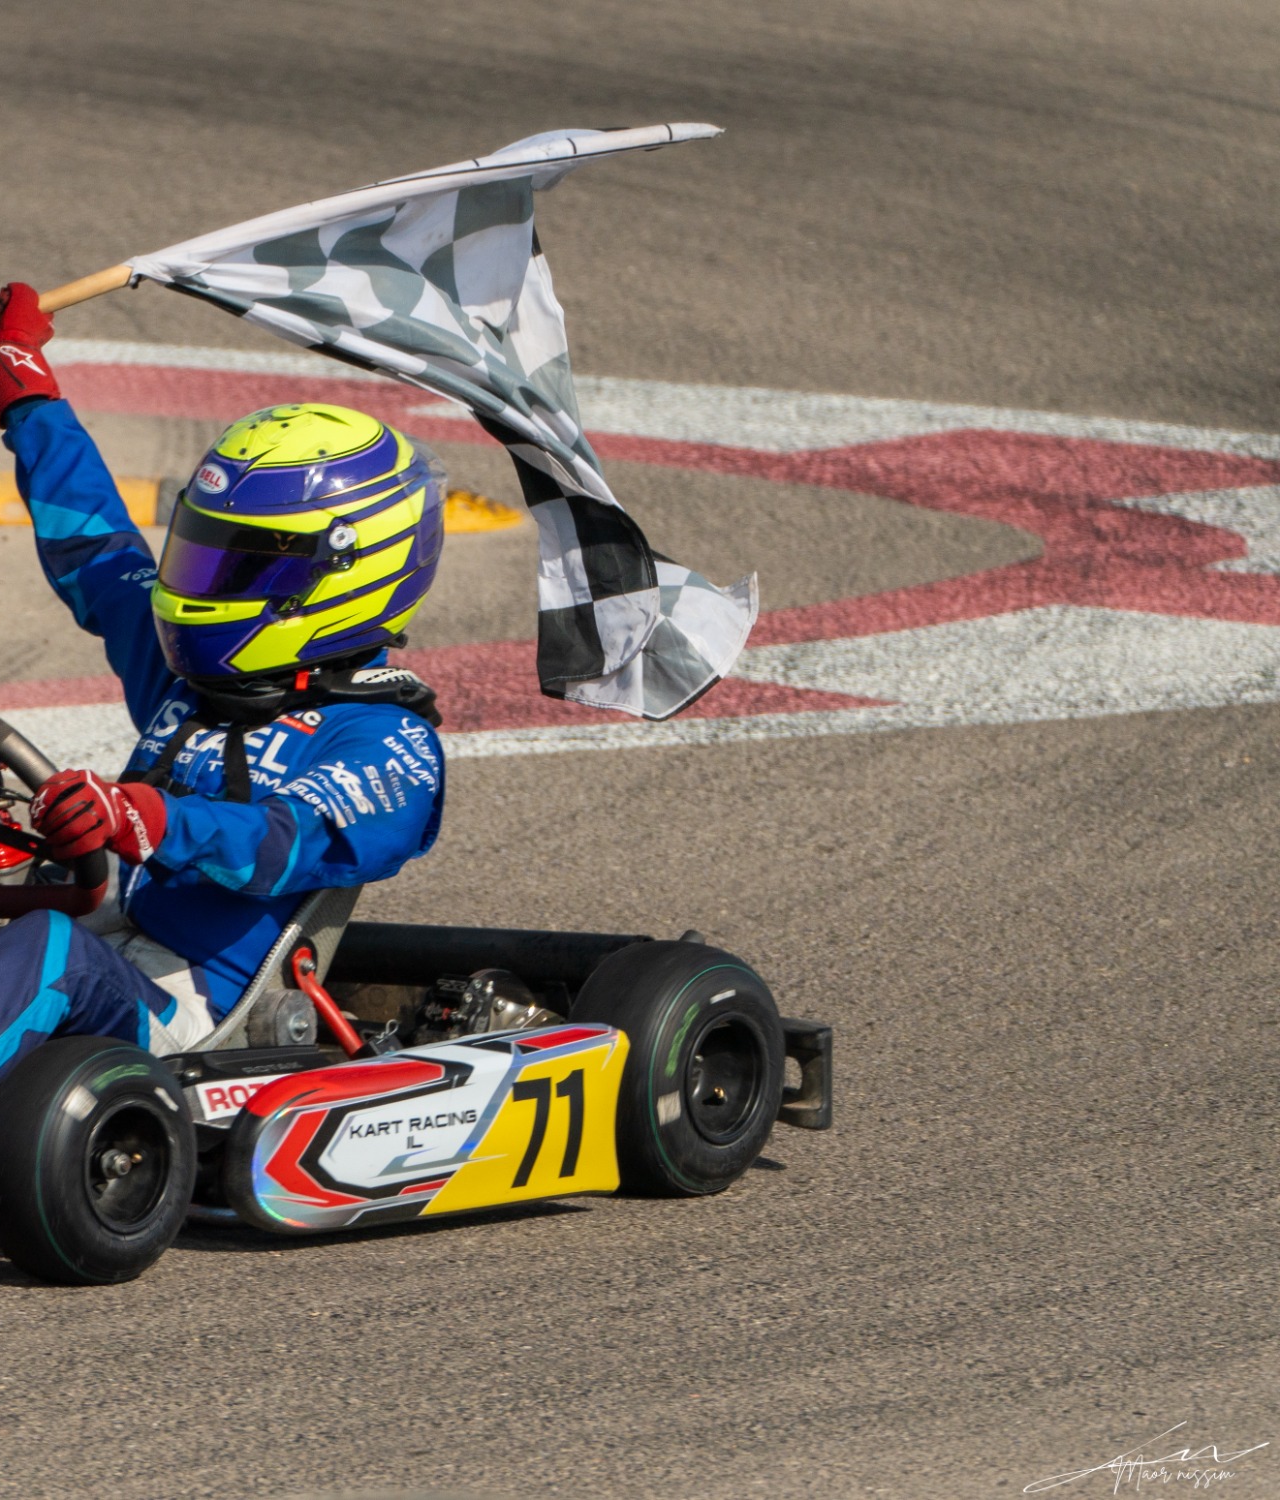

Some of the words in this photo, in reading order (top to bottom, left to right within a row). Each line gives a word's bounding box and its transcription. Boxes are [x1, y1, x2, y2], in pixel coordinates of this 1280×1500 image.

[197, 467, 223, 489] BELL
[207, 759, 283, 791] TAM
[362, 765, 395, 813] SODI
[349, 1120, 403, 1139] KART
[409, 1109, 477, 1132] RACING
[510, 1068, 585, 1188] 71
[406, 1136, 423, 1149] IL
